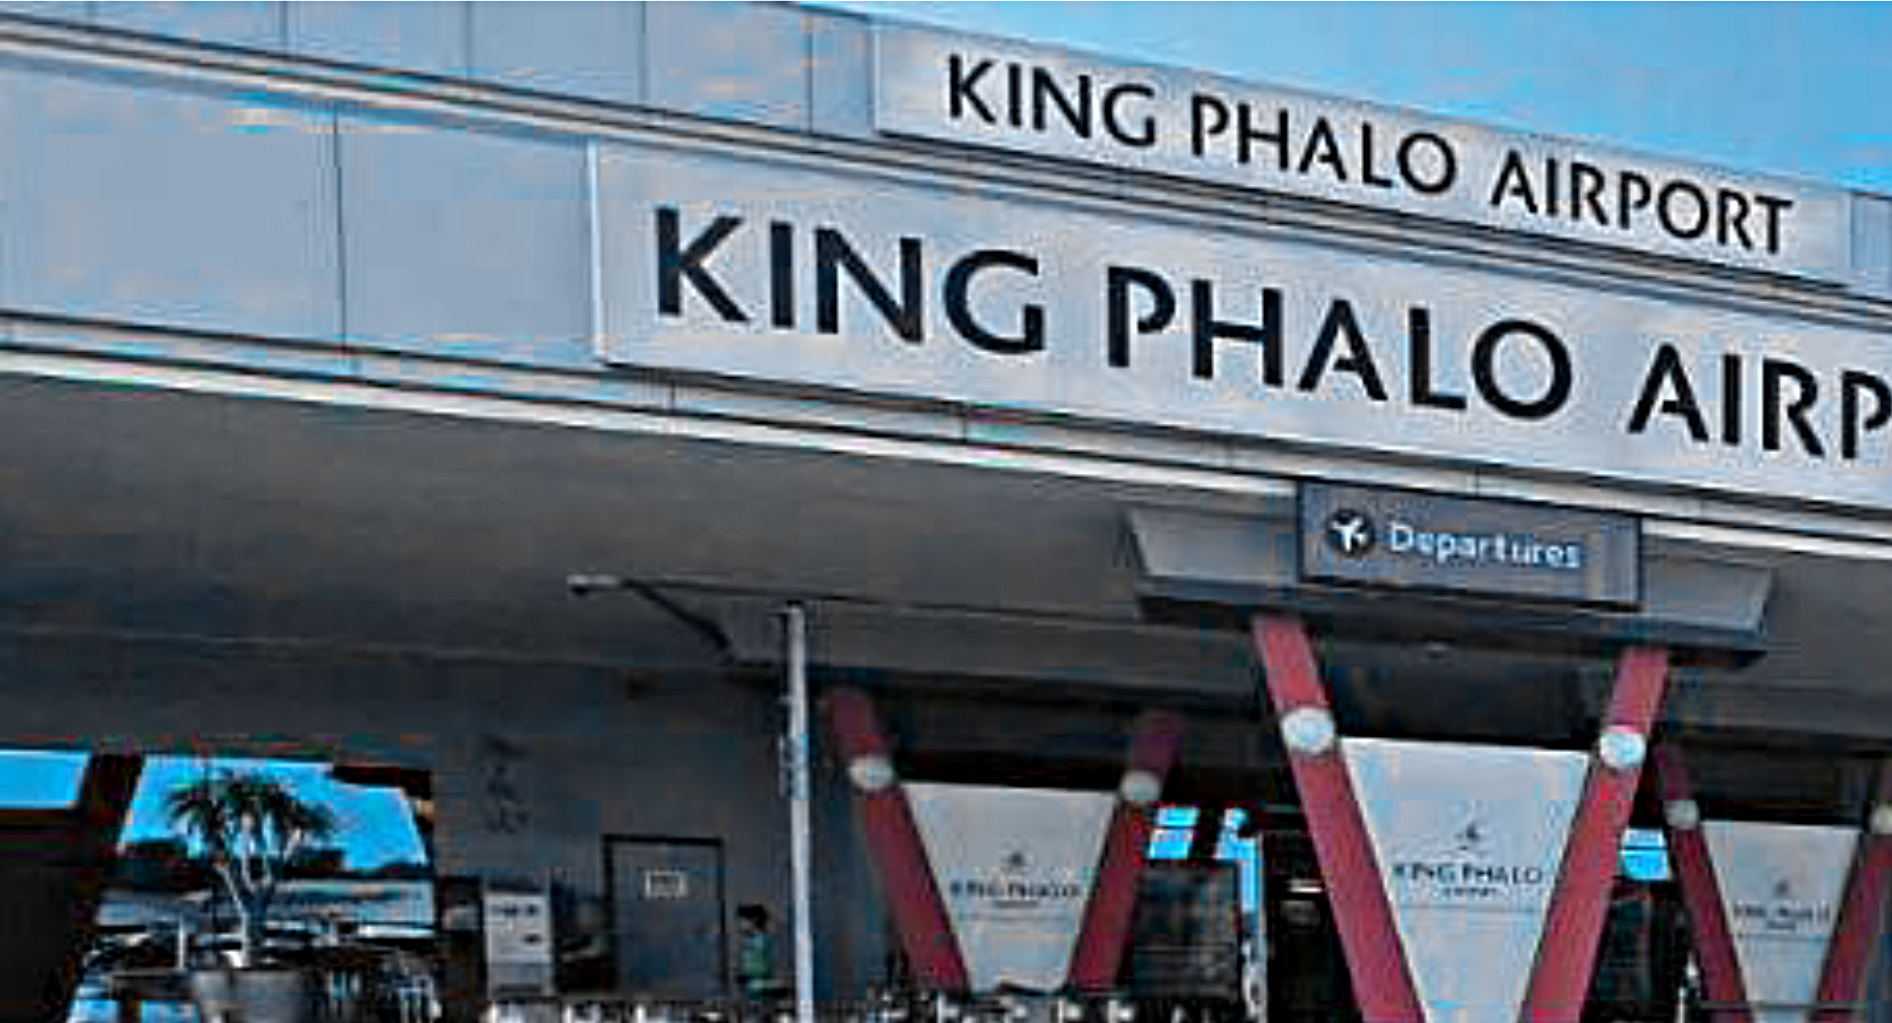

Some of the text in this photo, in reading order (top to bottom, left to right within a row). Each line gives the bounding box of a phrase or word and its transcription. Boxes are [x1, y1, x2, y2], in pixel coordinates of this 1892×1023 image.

[948, 53, 1794, 255] KING PHALO AIRPORT
[655, 207, 1046, 355] KING
[1106, 265, 1574, 420] PHALO
[1388, 520, 1582, 569] Departures
